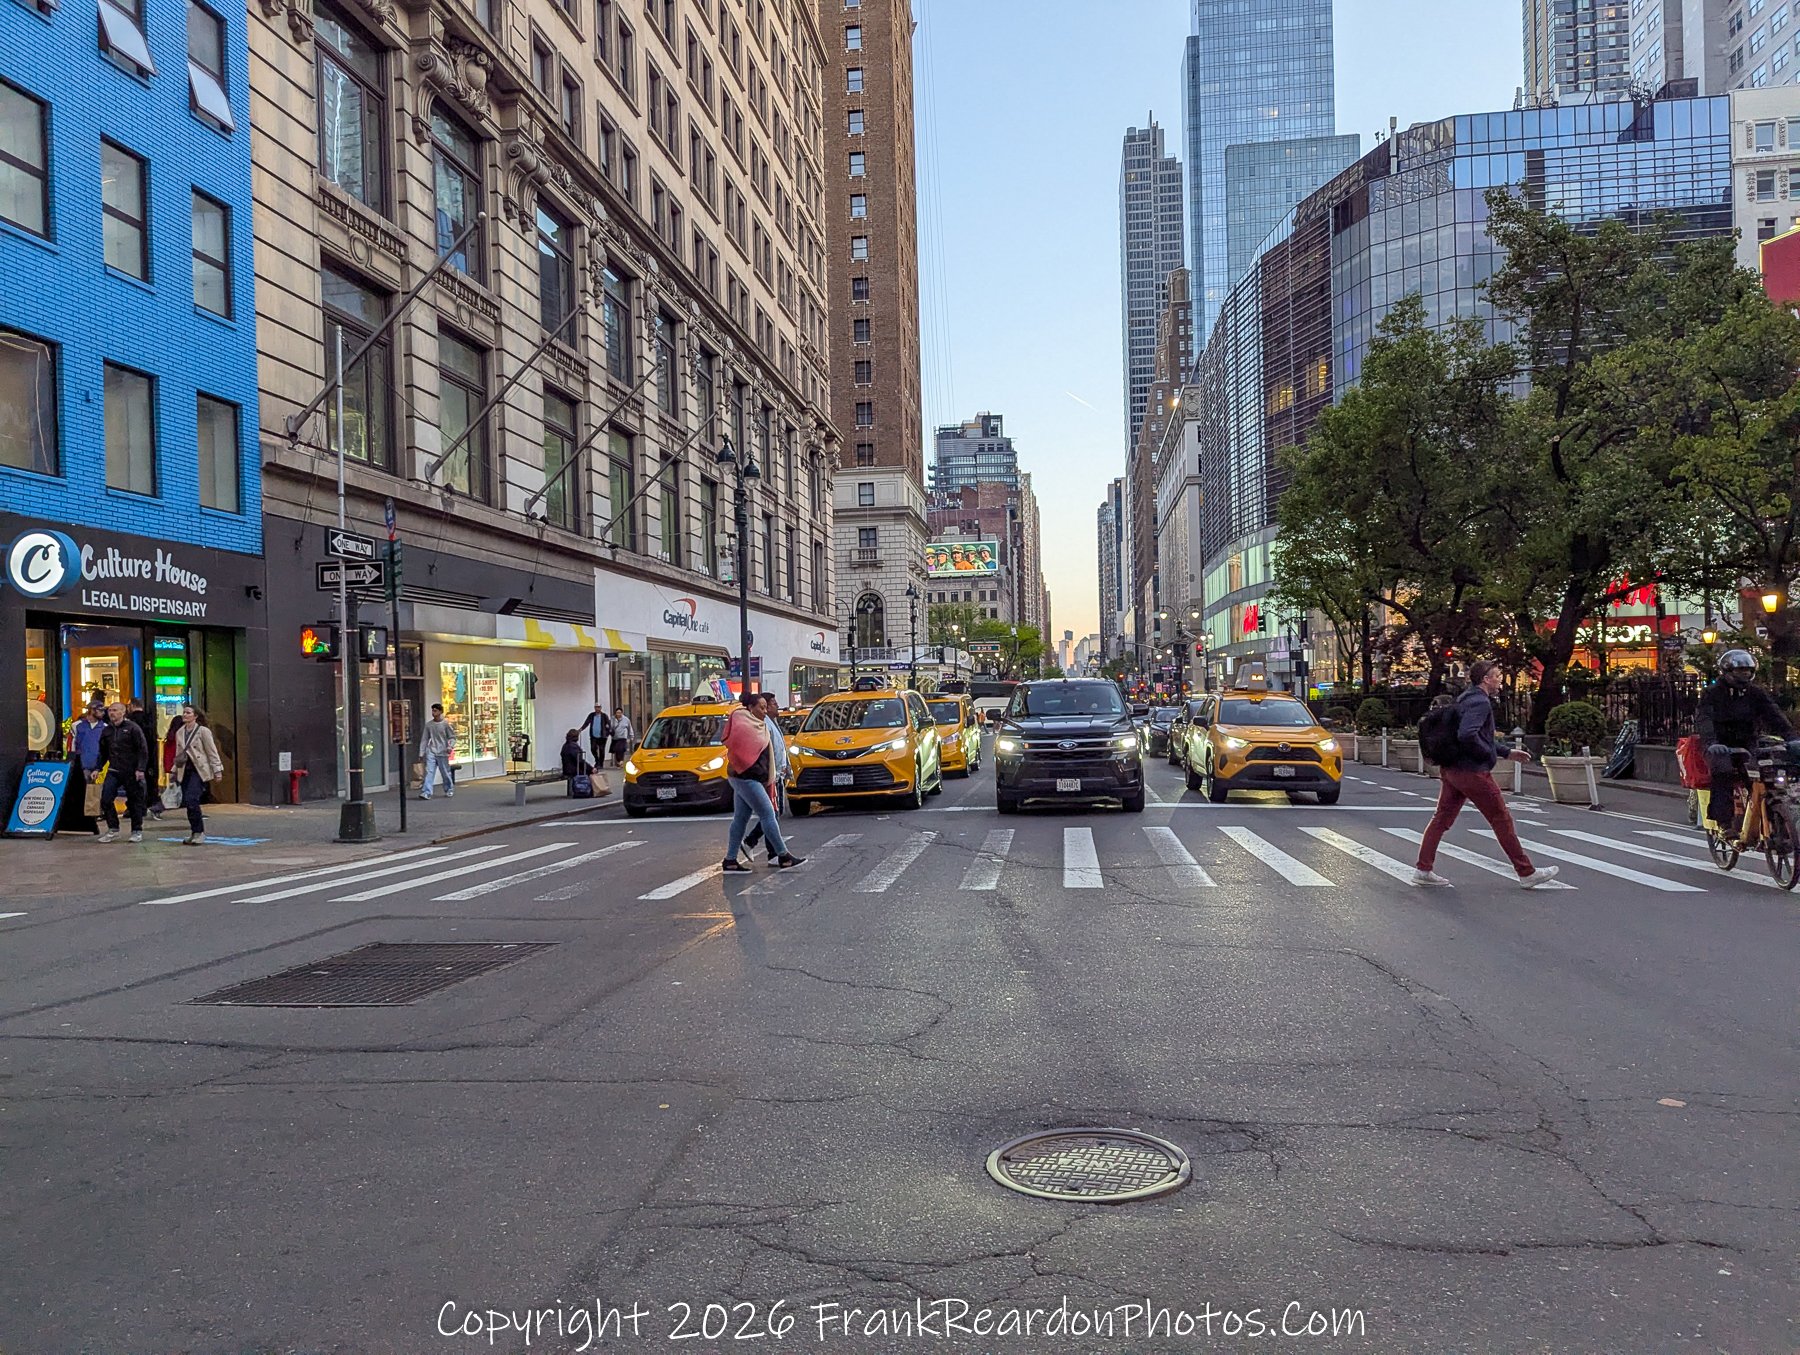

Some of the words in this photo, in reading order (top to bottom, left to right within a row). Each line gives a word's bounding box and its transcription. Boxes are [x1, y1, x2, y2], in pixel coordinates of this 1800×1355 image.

[336, 539, 350, 550] ONE
[355, 543, 368, 555] WAY
[80, 544, 151, 581] Culture
[155, 548, 207, 595] House
[354, 570, 374, 580] WAY
[82, 589, 128, 610] LEGAL
[130, 595, 207, 617] DISPENSARY
[699, 621, 709, 634] café
[27, 769, 50, 777] Culture
